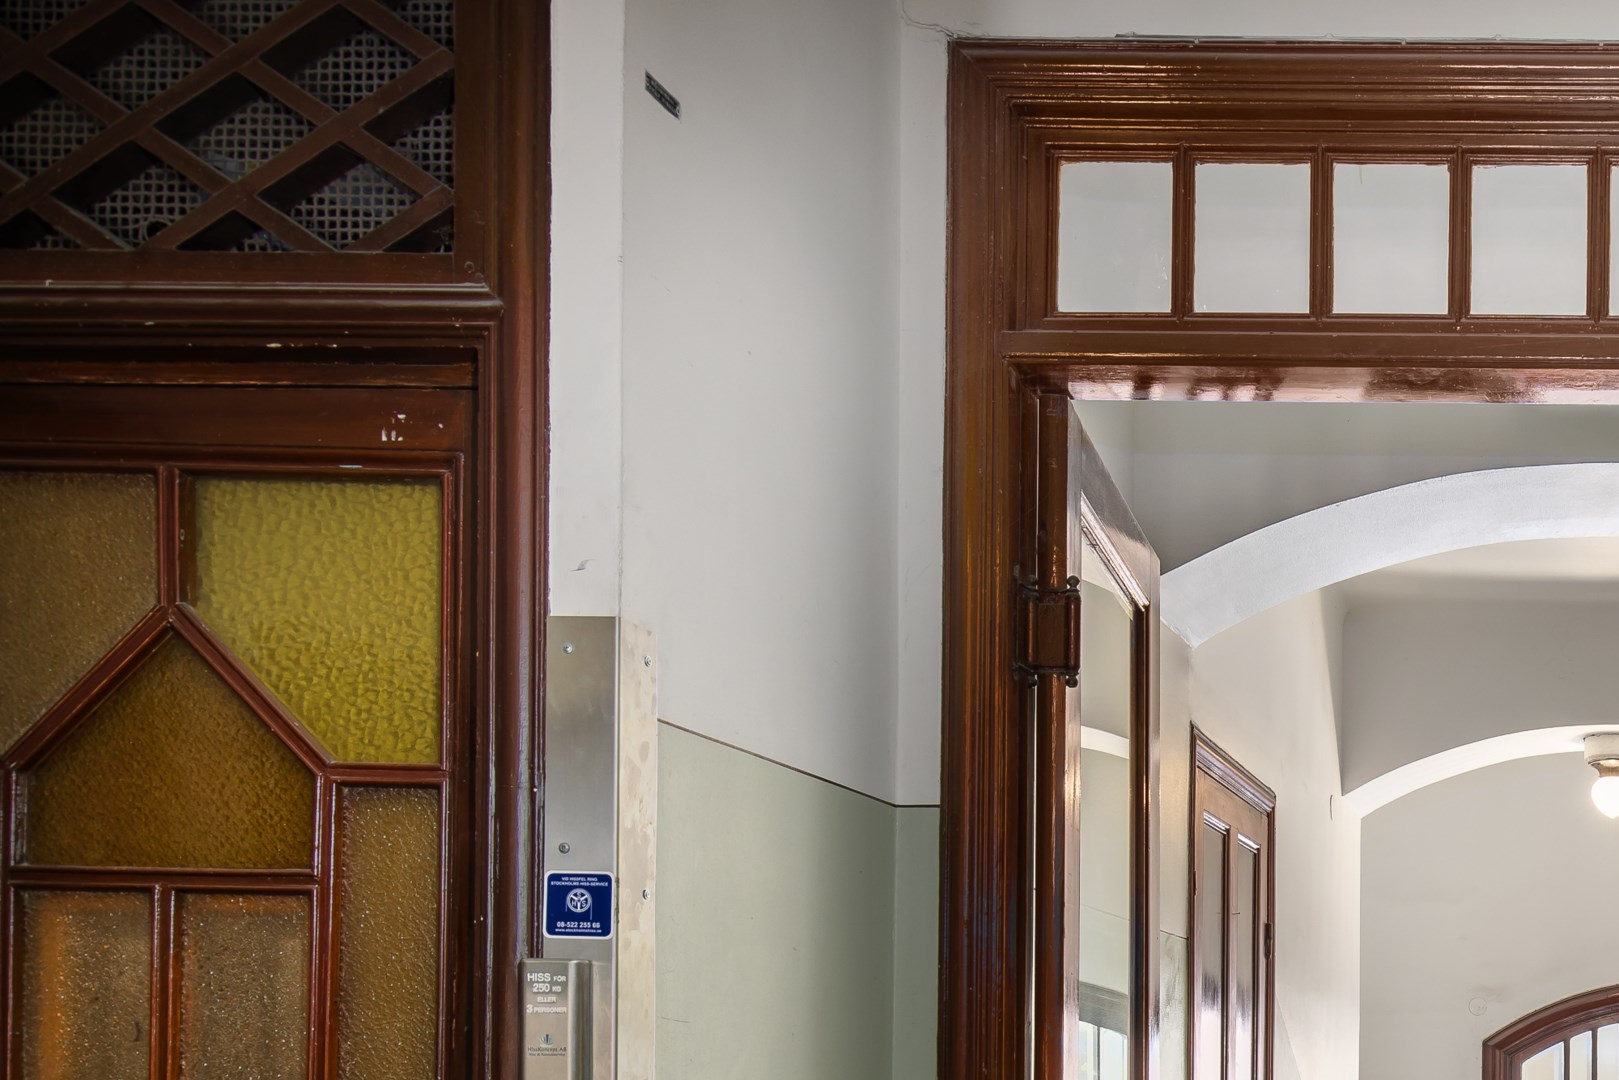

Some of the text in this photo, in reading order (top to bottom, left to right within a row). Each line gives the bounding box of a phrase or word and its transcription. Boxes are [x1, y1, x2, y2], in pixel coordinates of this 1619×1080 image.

[527, 973, 551, 982] HISS
[532, 983, 550, 992] 250
[526, 1004, 567, 1014] 3 PERSONER
